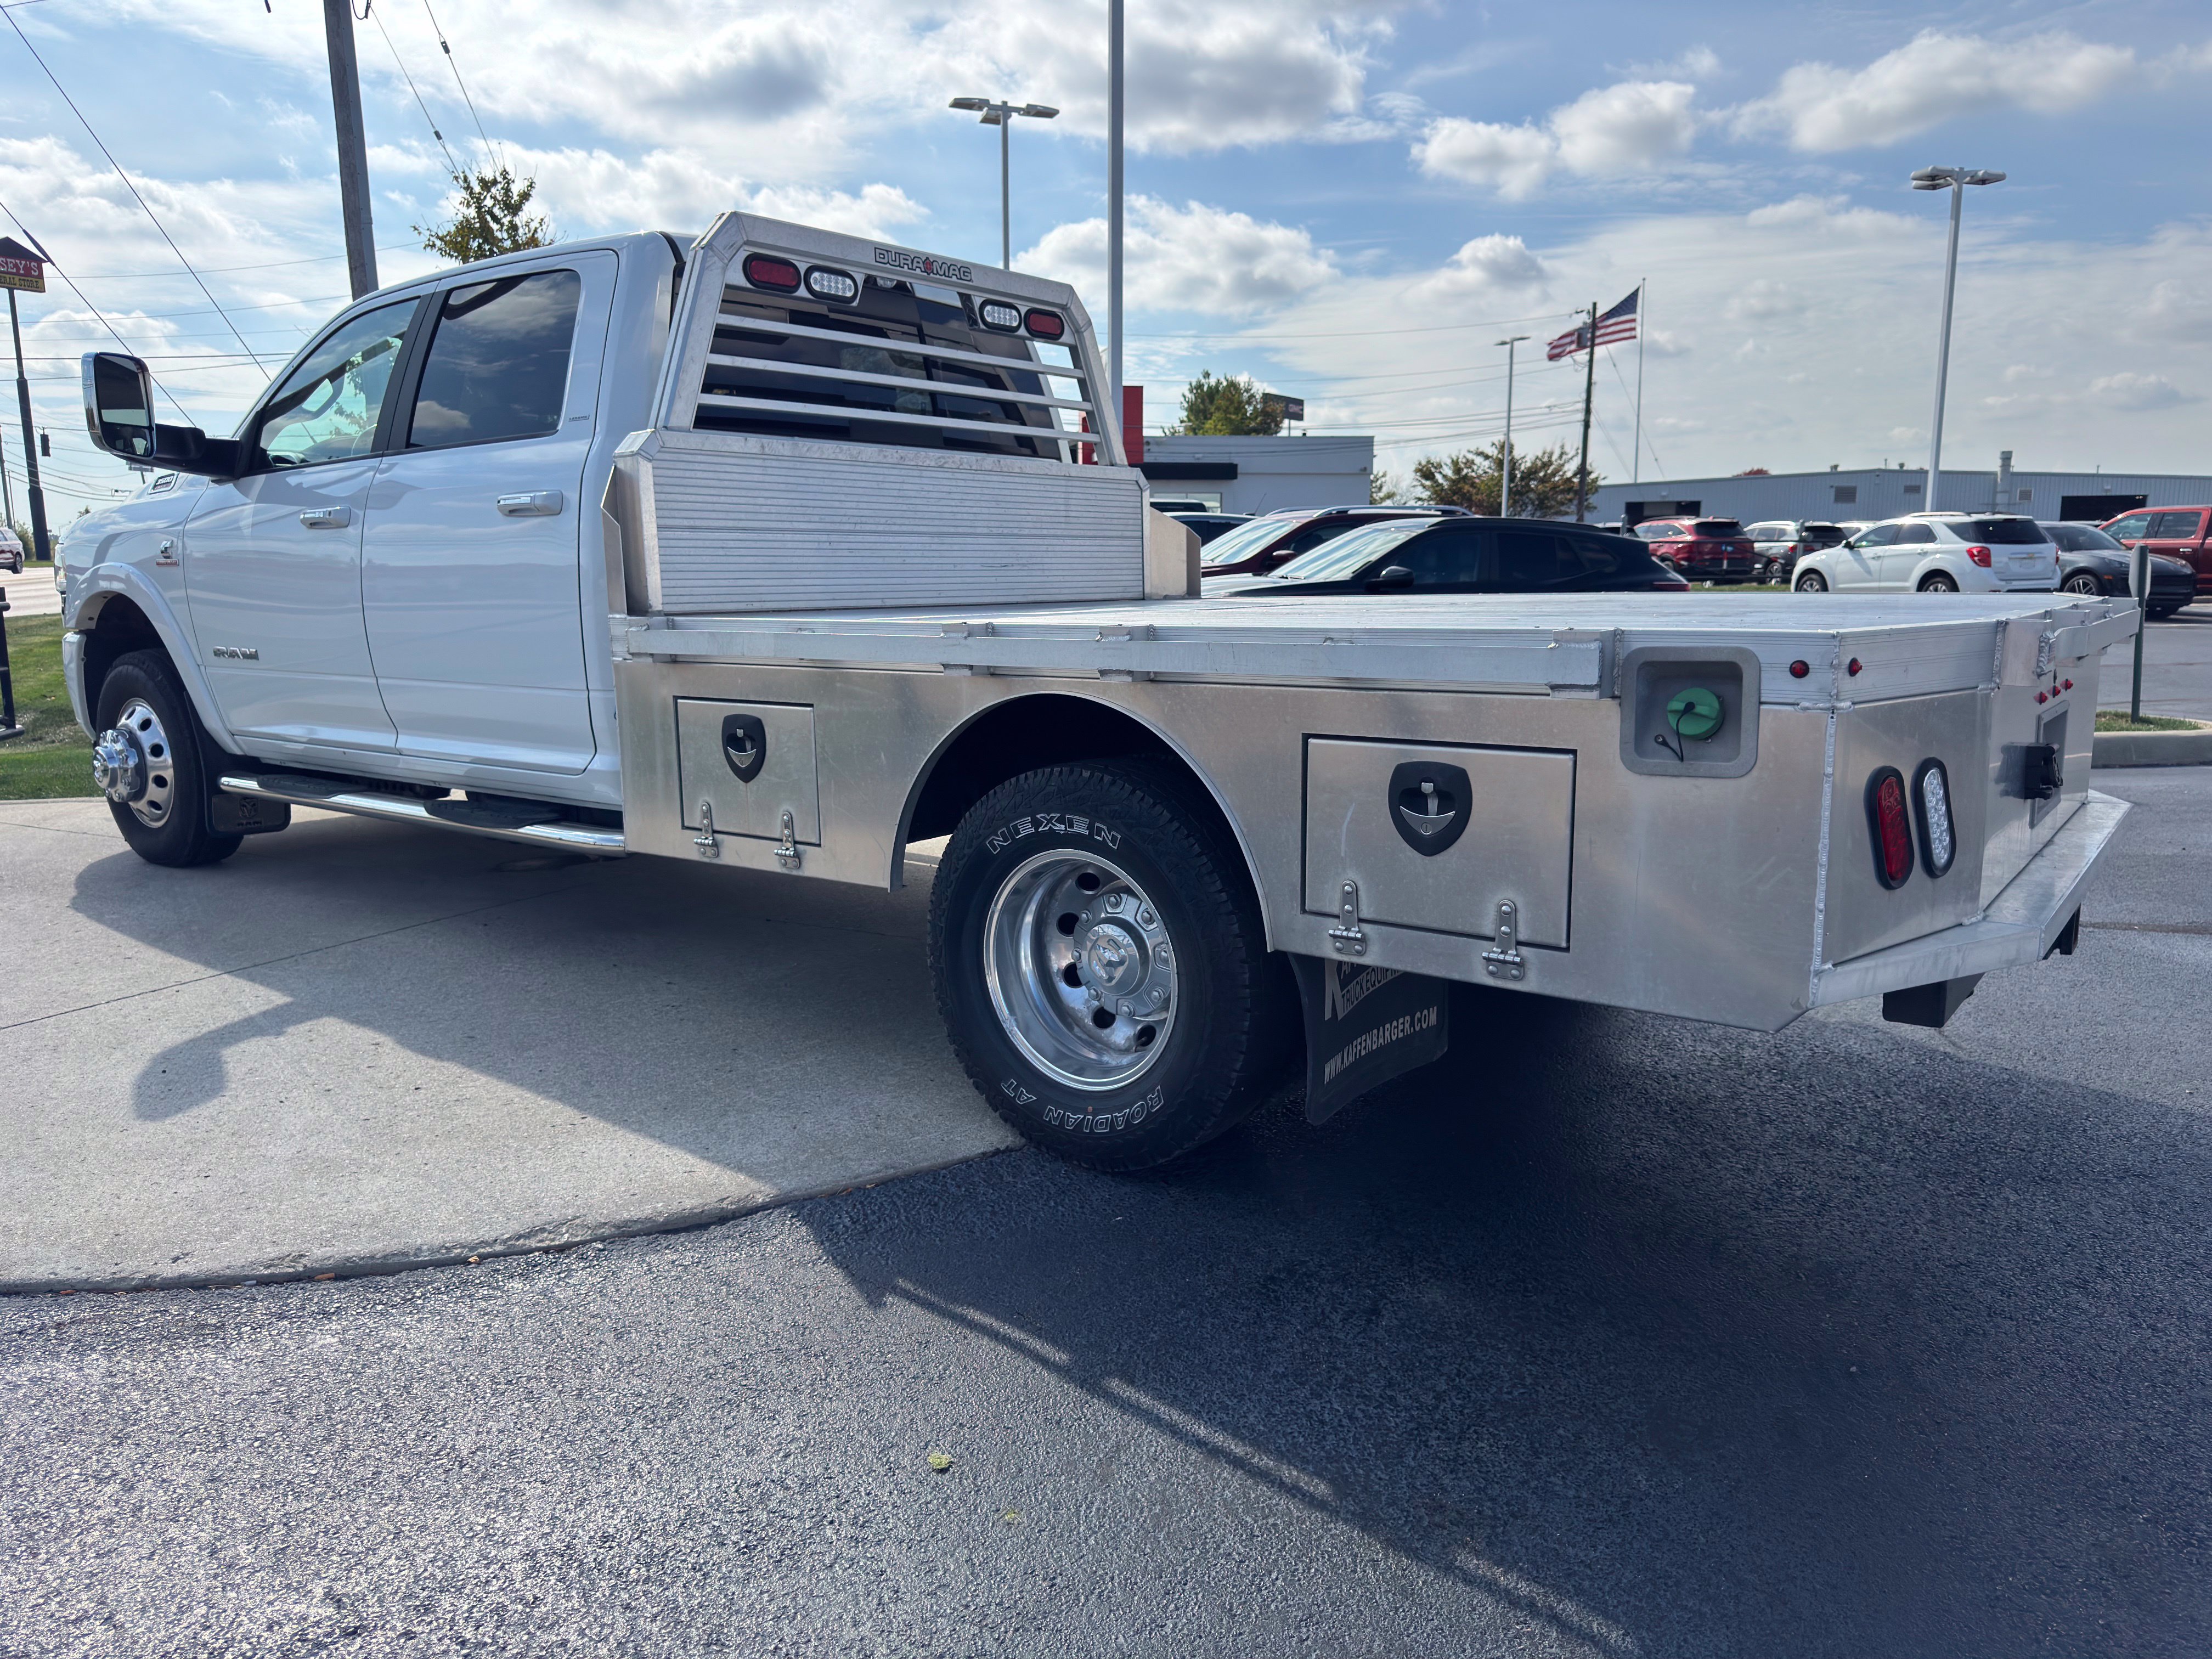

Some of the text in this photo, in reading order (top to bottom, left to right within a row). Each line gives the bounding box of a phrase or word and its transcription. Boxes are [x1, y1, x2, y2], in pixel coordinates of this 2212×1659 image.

[18, 278, 40, 289] STORE
[213, 646, 259, 661] RAM
[986, 813, 1121, 854] NEXEN
[1341, 975, 1365, 1014] TRUCK
[1324, 1006, 1437, 1084] WWW.KAFFENBARGER.COM
[1000, 1079, 1164, 1132] ROADIAN AT
